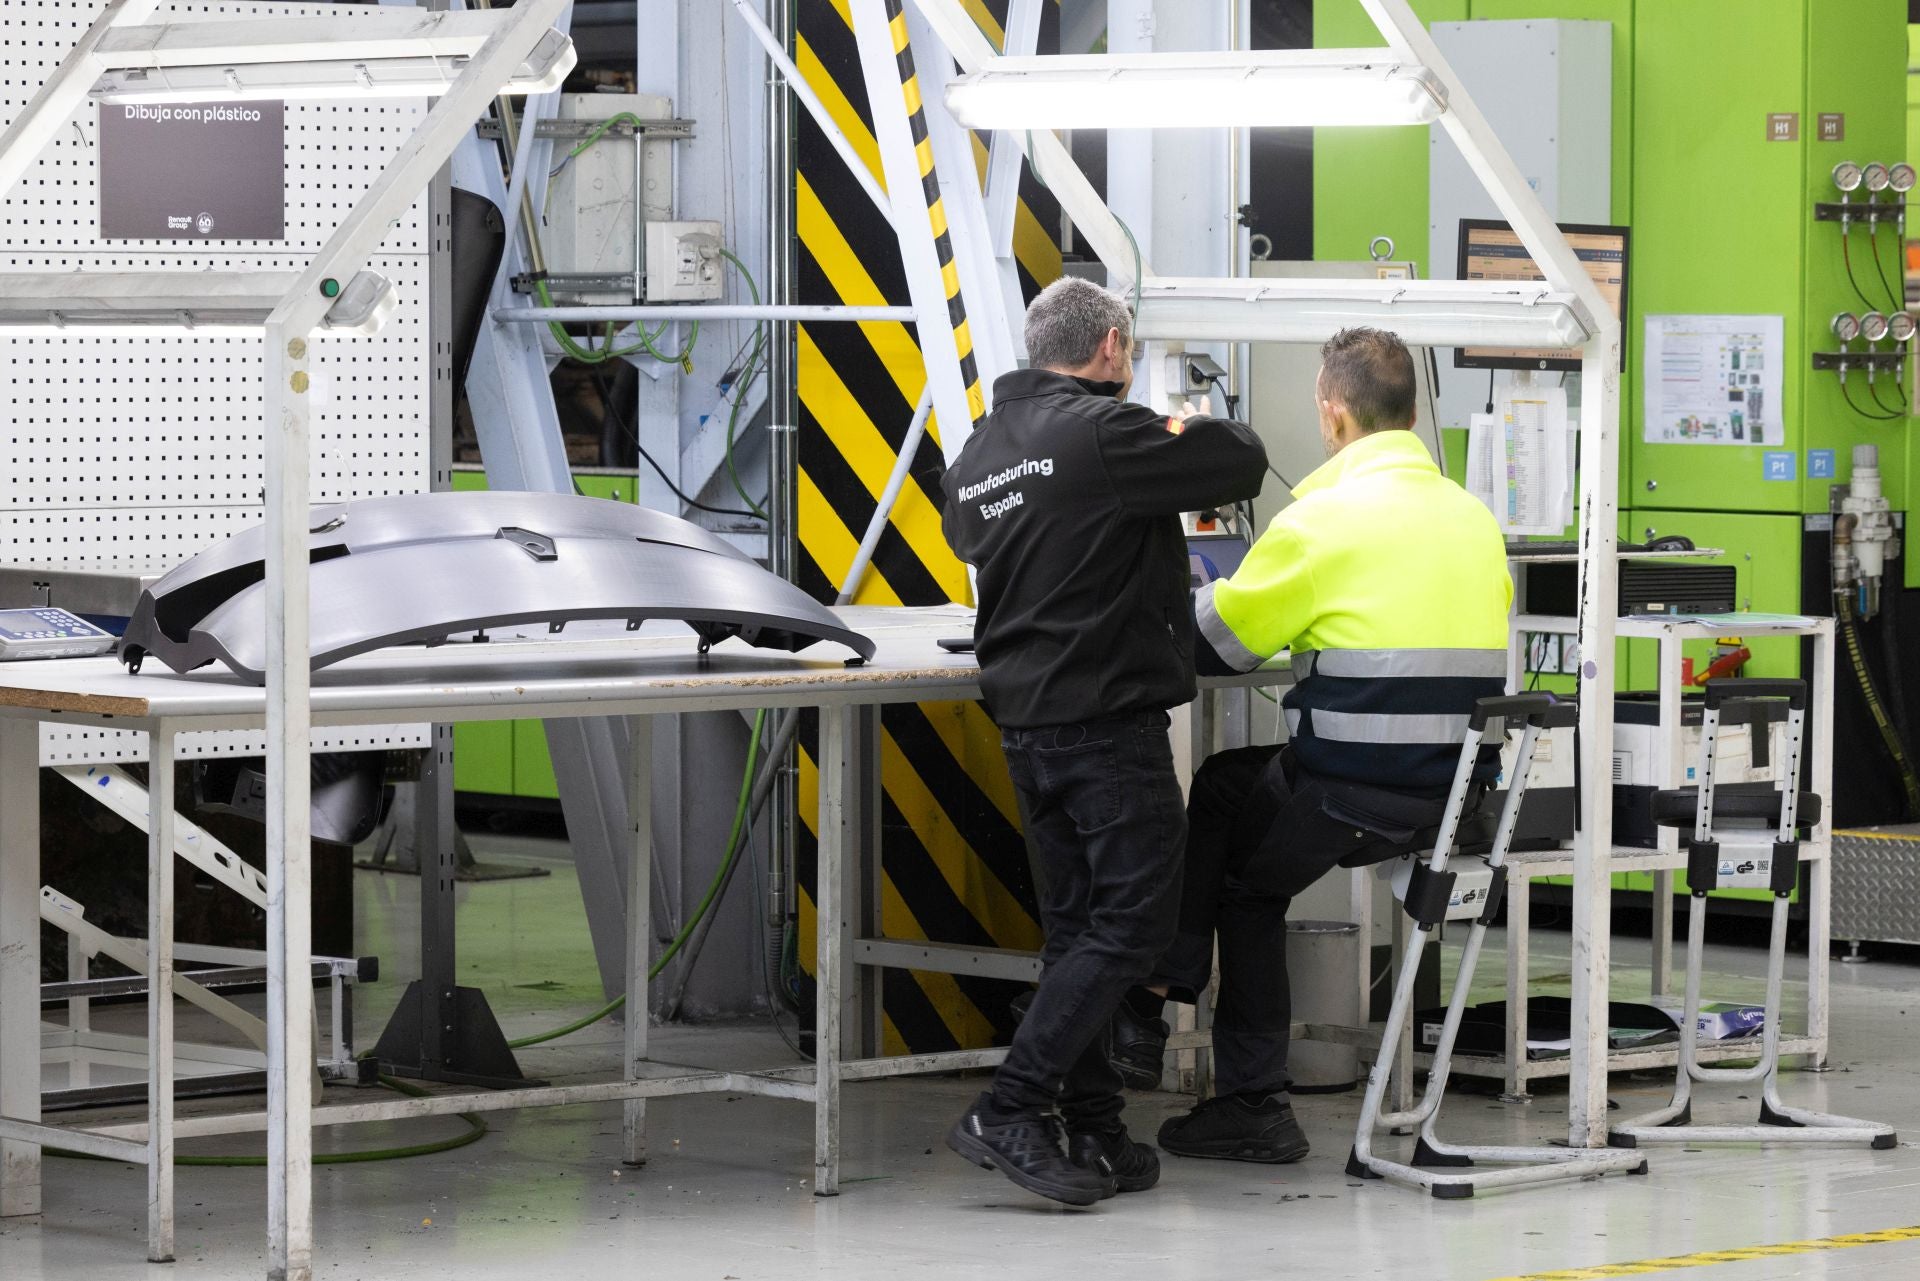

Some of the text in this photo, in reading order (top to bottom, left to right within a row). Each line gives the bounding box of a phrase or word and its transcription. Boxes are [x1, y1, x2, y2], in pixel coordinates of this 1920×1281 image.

[125, 105, 261, 124] Dibuja con plástico
[1775, 122, 1789, 134] H1
[1824, 122, 1836, 134] H1
[168, 222, 188, 230] Group
[1772, 461, 1785, 473] P1
[1815, 458, 1826, 471] P1
[958, 458, 1054, 504] Manufacturing
[980, 491, 1024, 520] España
